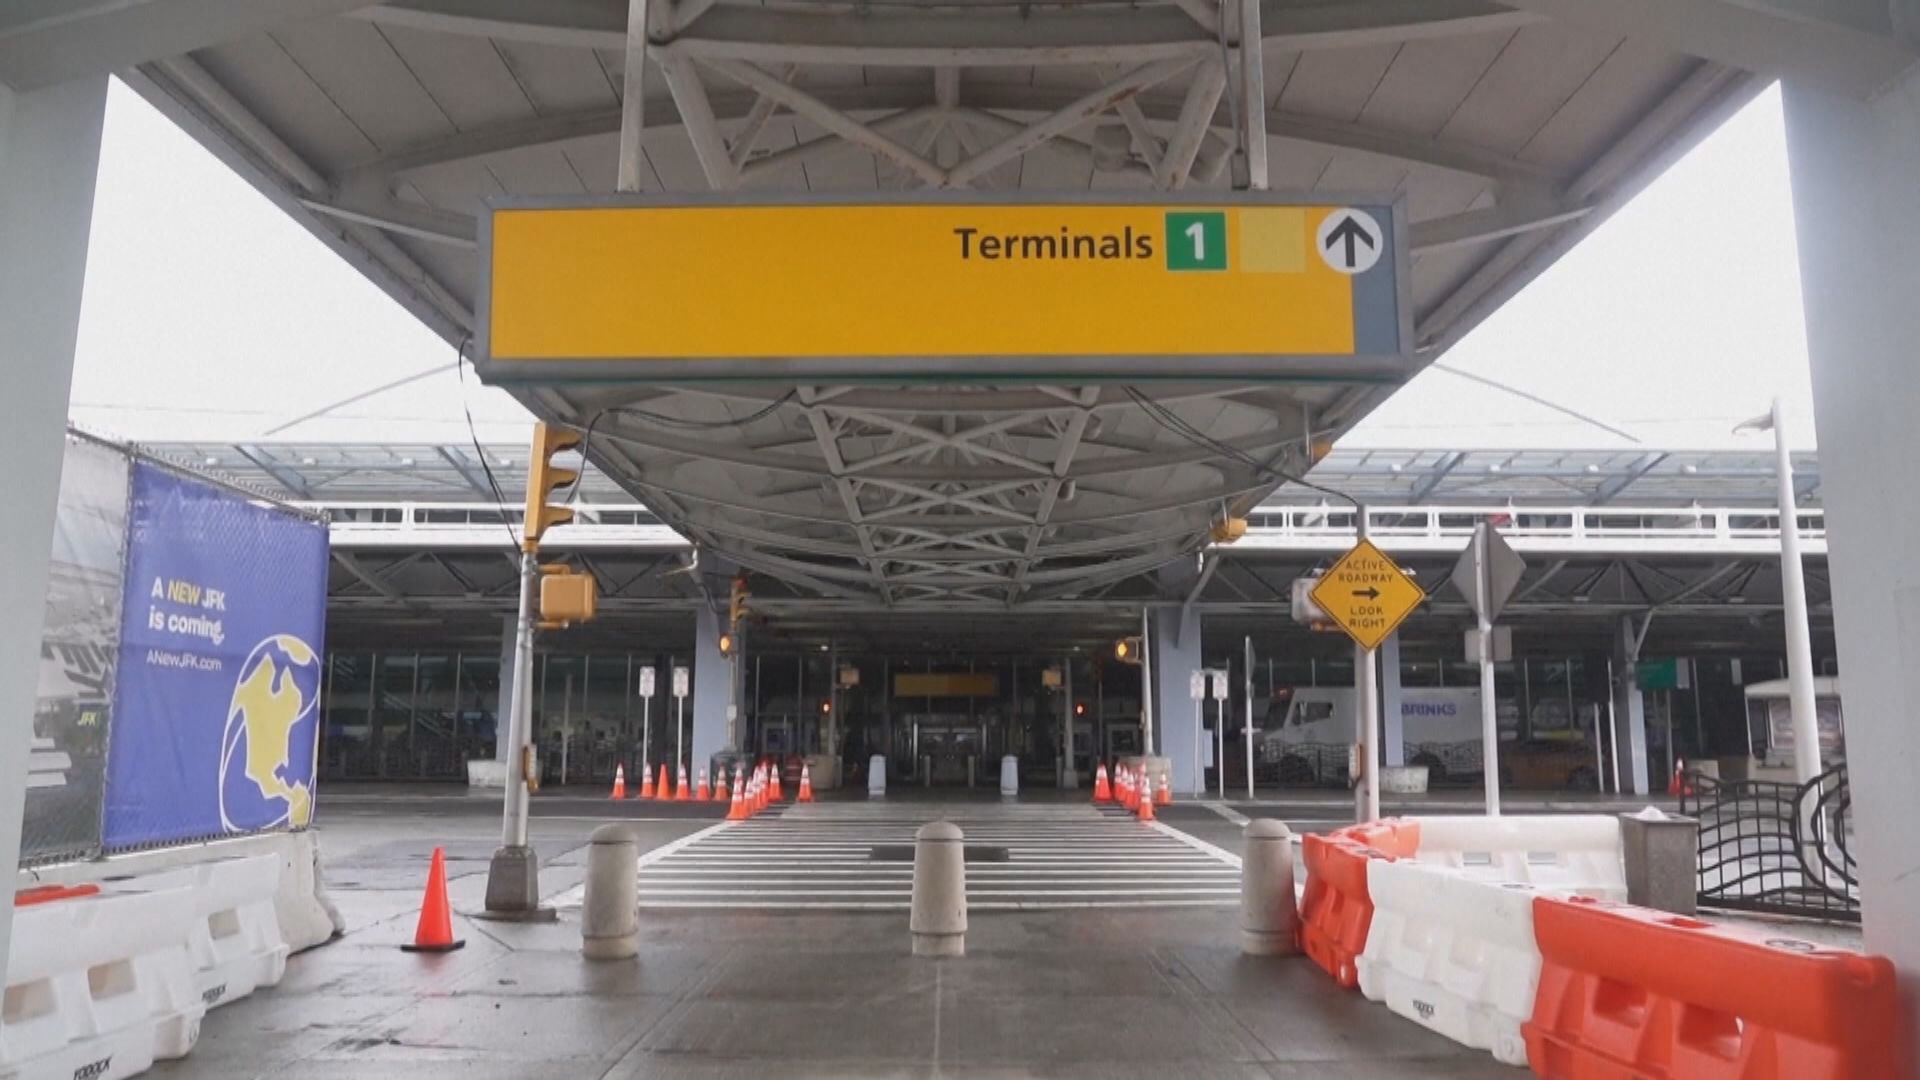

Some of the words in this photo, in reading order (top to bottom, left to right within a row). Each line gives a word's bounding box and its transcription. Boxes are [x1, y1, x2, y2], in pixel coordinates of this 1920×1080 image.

[953, 226, 1153, 259] Terminals
[1185, 222, 1205, 261] 1
[1345, 559, 1386, 570] ACTIVE
[1338, 573, 1393, 583] ROADWAY
[151, 576, 164, 599] A
[167, 579, 201, 605] NEW
[202, 588, 225, 611] JFK
[148, 605, 164, 630] is
[1350, 606, 1383, 615] LOOK
[1349, 619, 1385, 628] RIGHT
[146, 649, 222, 671] ANewJFK.com
[77, 711, 97, 727] JFK
